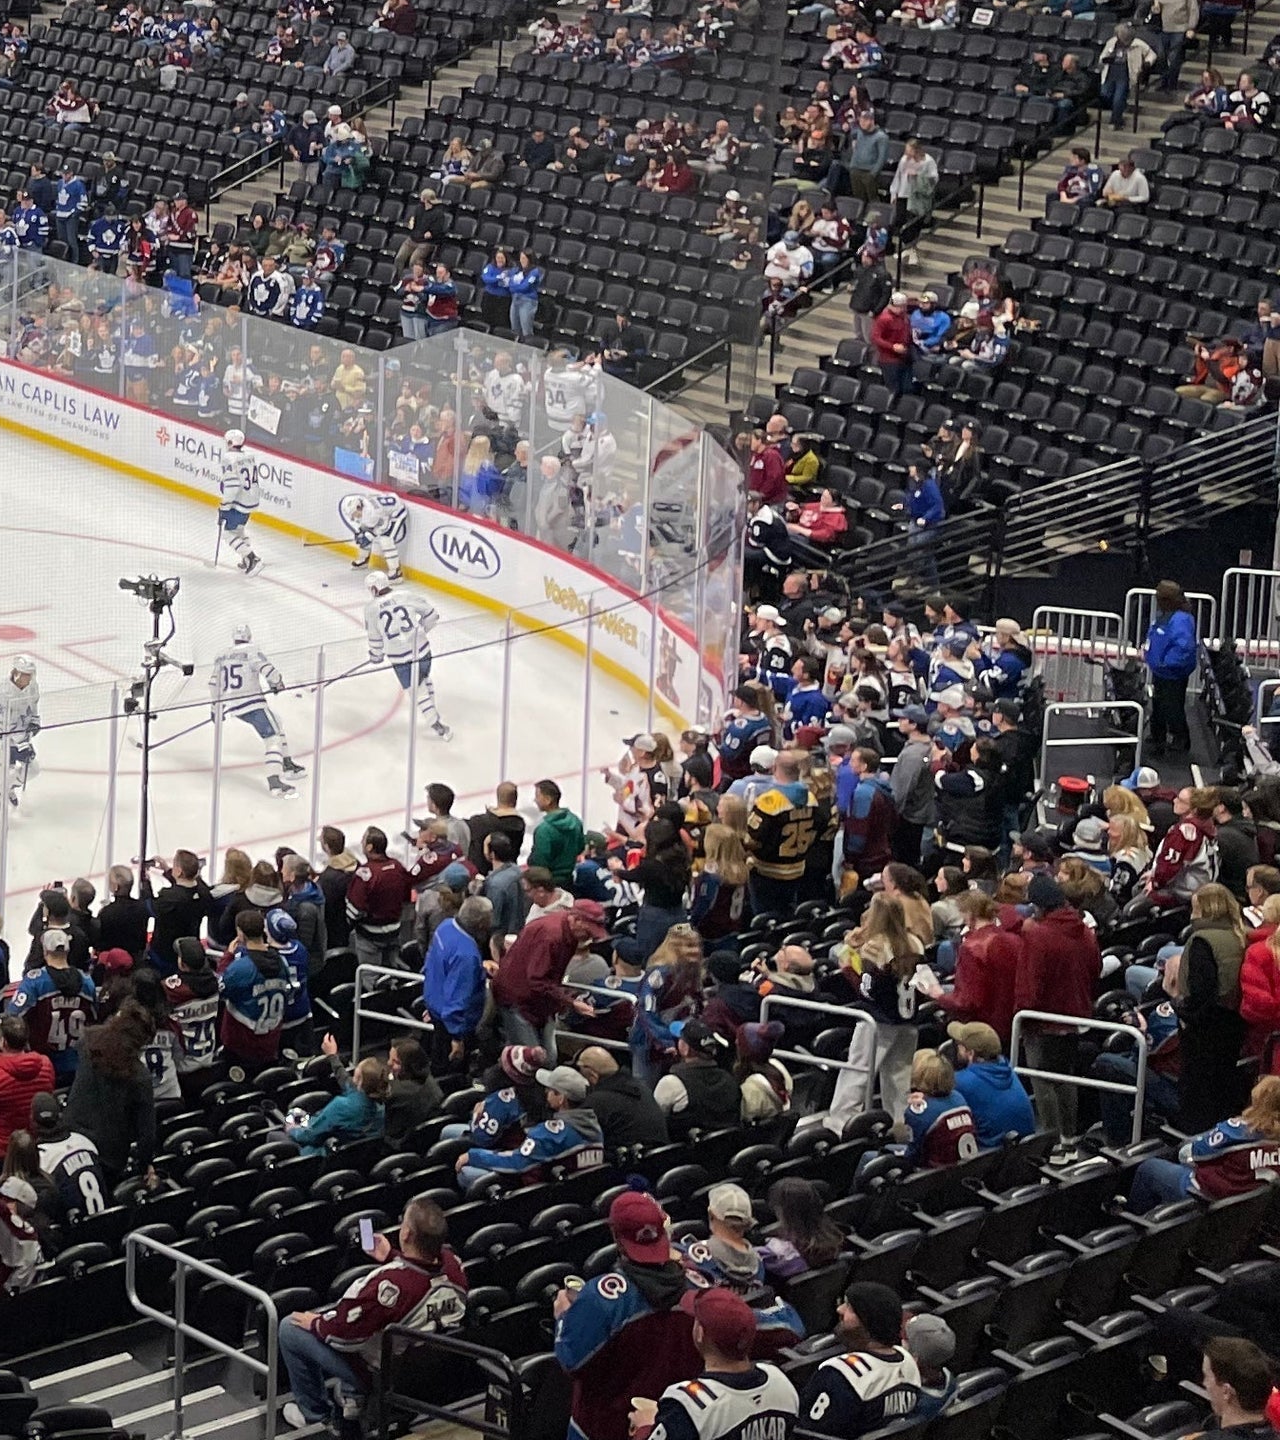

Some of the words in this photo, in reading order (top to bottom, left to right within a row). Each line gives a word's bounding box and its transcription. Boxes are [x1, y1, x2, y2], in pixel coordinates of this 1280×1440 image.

[21, 382, 77, 416] CAPLIS
[83, 402, 121, 431] LAW
[175, 433, 208, 460] HCA
[174, 457, 201, 477] Rocky
[240, 465, 260, 492] 34
[441, 533, 488, 568] IMA
[379, 605, 414, 641] 23
[47, 1008, 87, 1053] 49
[809, 1391, 831, 1421] 8
